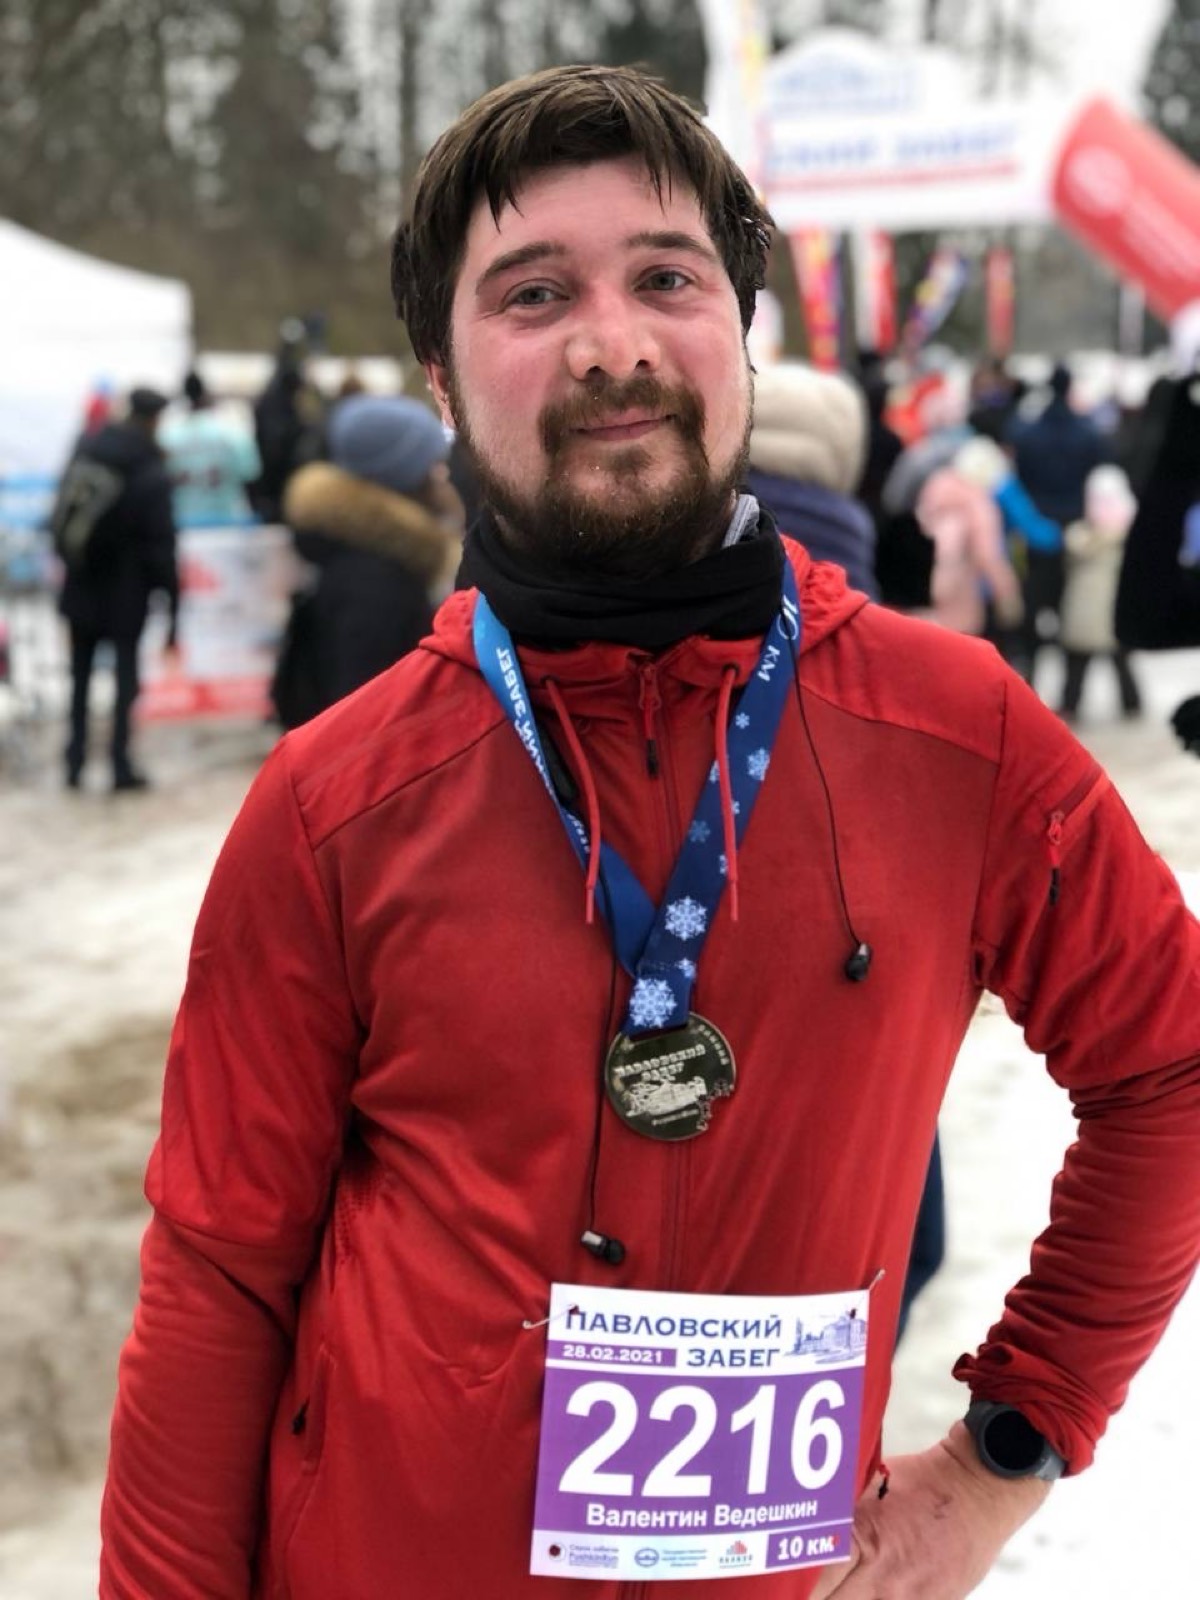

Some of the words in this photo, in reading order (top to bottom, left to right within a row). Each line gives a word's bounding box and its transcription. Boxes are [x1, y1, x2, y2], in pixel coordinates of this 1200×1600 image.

[496, 647, 527, 717] ЗАБЕГ
[565, 1312, 782, 1339] ПАВЛОВСКИЙ
[563, 1345, 663, 1364] 28.02.2021
[686, 1348, 780, 1368] ЗАБЕГ
[558, 1379, 846, 1497] 2216
[586, 1503, 707, 1528] Валентин
[714, 1500, 818, 1527] Ведешкин
[778, 1536, 803, 1560] 10
[807, 1536, 835, 1556] км
